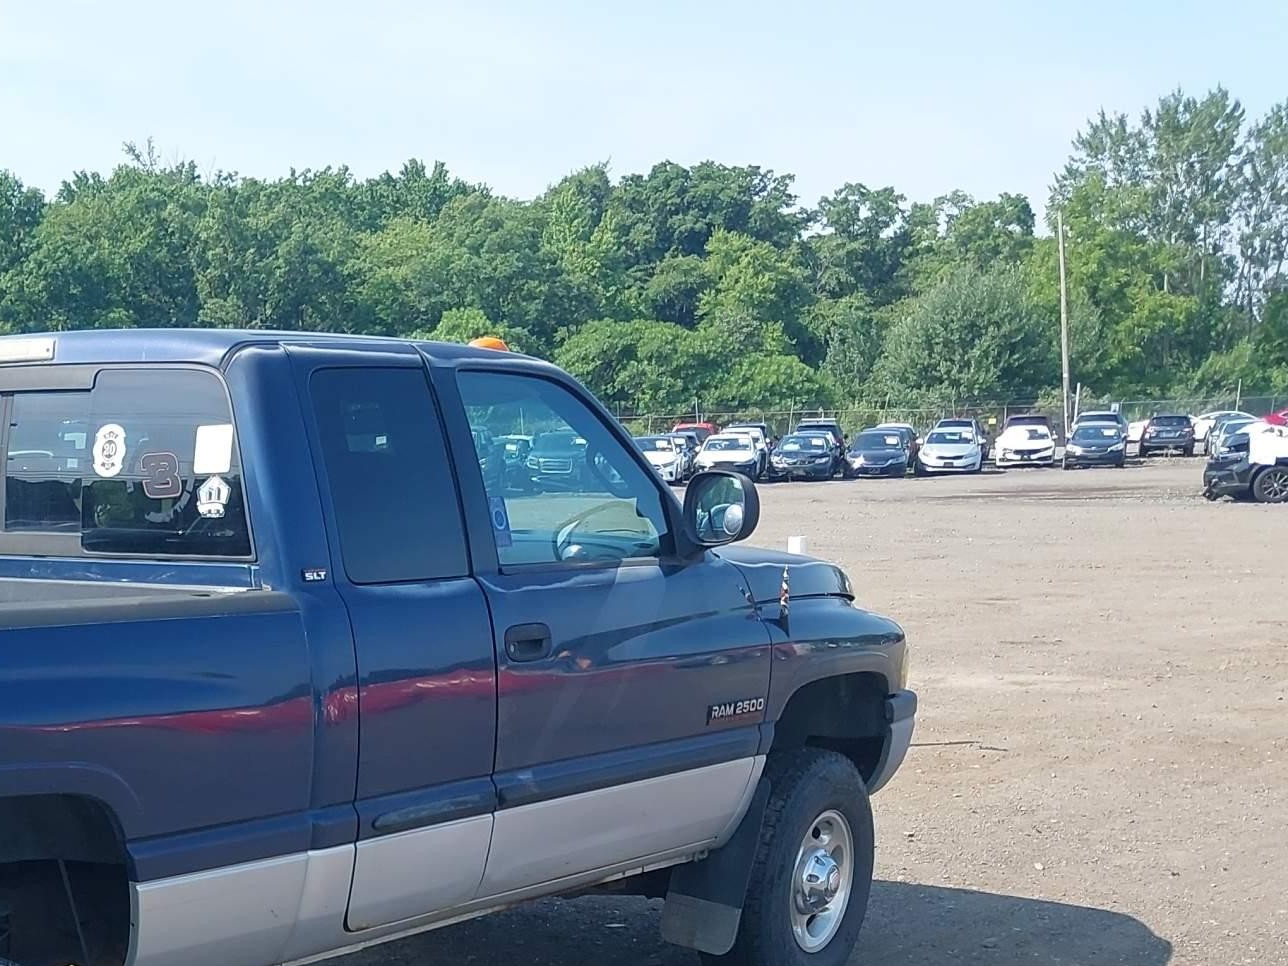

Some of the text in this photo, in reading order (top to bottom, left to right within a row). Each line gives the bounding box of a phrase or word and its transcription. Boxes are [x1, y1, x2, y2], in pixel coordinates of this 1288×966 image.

[305, 571, 327, 581] SLT
[711, 698, 764, 719] RAM 2500
